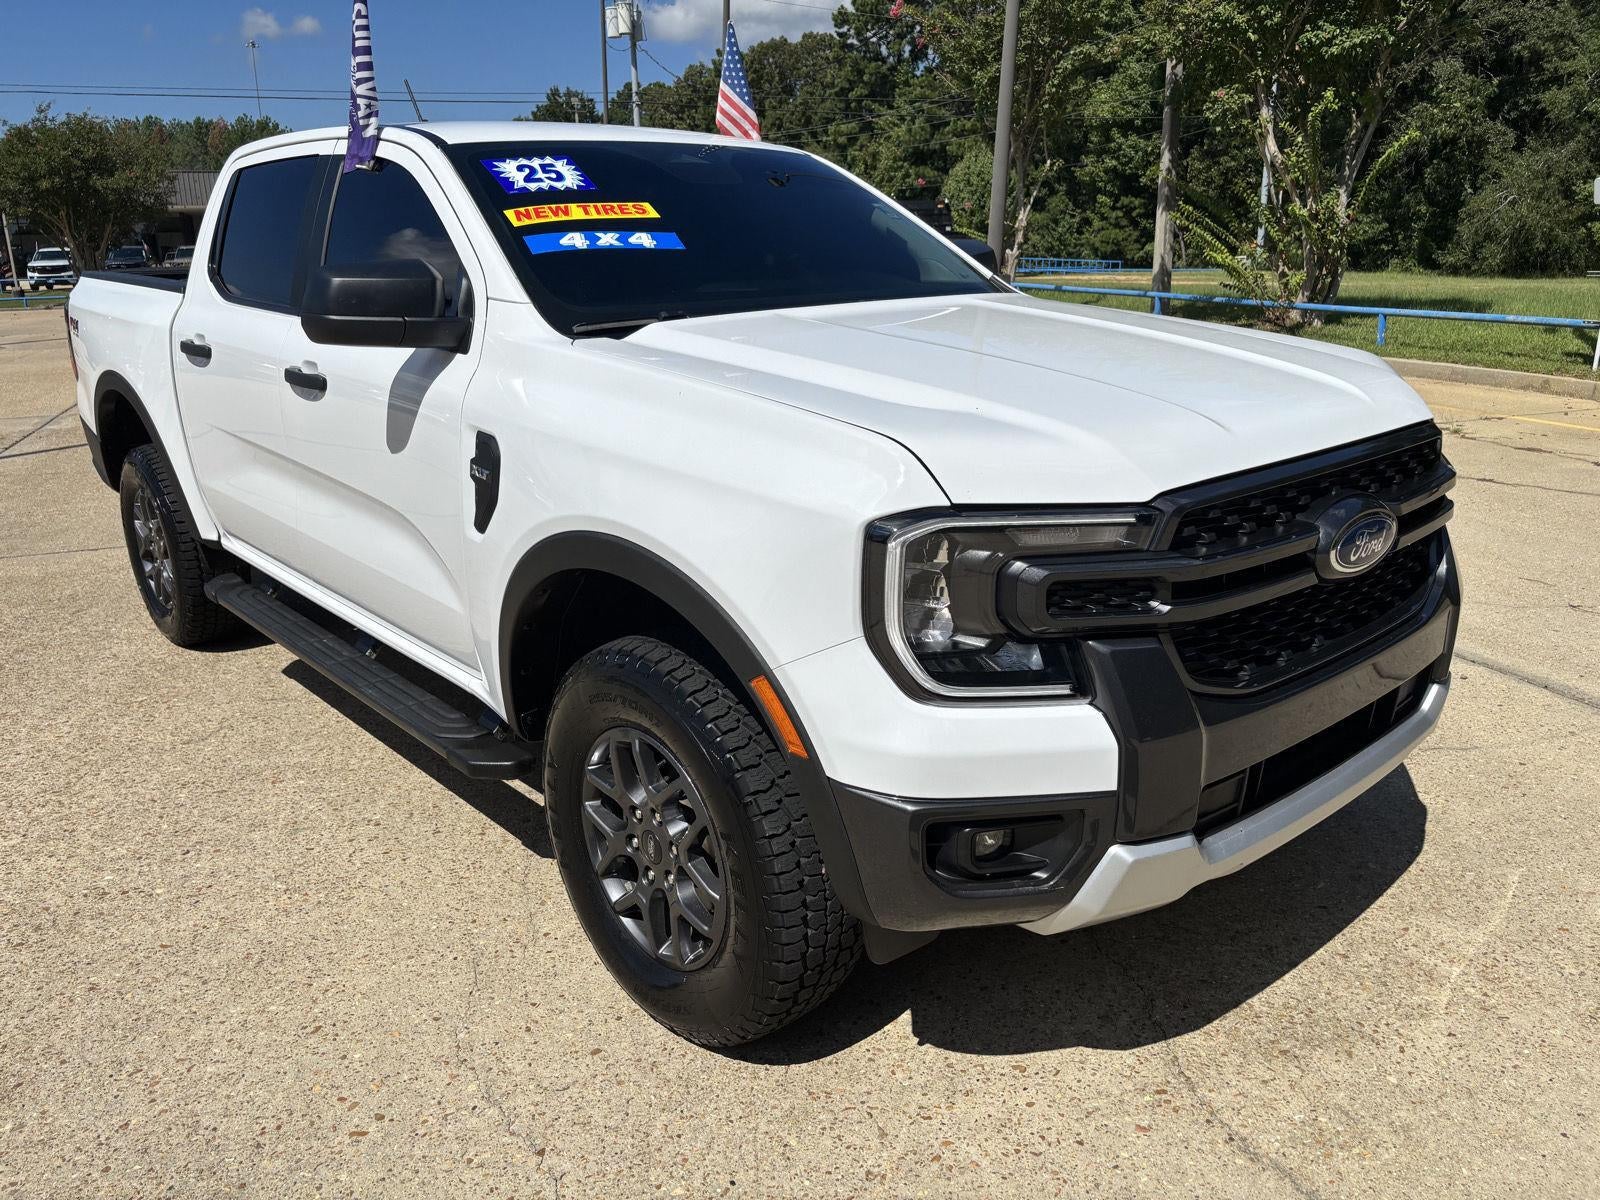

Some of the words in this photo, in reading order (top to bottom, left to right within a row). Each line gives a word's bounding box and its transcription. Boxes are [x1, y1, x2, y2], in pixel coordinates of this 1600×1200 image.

[516, 163, 567, 184] 25
[513, 204, 572, 222] NEW
[576, 203, 649, 217] TIRES
[1351, 525, 1386, 562] Ford
